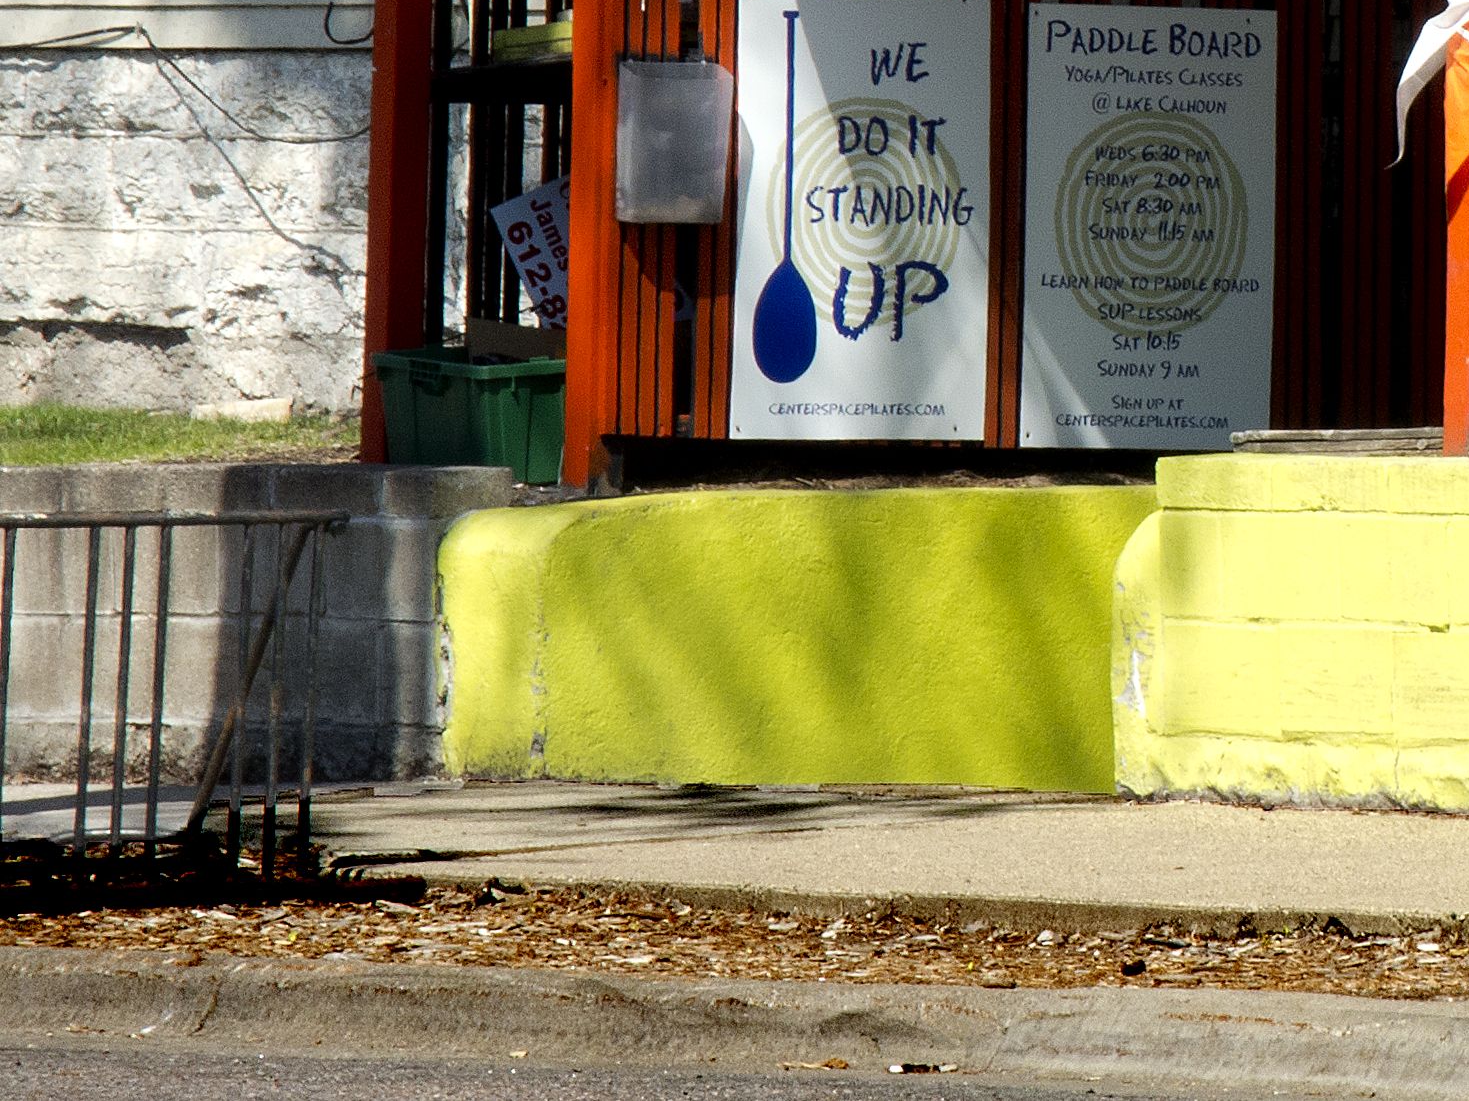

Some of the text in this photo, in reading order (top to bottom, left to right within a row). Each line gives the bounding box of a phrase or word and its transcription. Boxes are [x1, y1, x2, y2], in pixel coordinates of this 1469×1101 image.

[1045, 20, 1261, 59] PADDLE BOARD
[870, 42, 930, 85] WE
[1064, 65, 1243, 87] YOGA/PILATES CLASSES
[1092, 92, 1227, 114] @ LAKE CALHOUN
[837, 115, 947, 158] DO IT
[1095, 147, 1136, 162] WEDS
[1185, 148, 1210, 163] PM
[1084, 170, 1138, 188] FRIDAY
[1196, 176, 1221, 189] PM
[805, 185, 975, 227] STANDING
[1102, 198, 1131, 215] SAT
[1179, 202, 1202, 215] AM
[530, 200, 567, 272] James
[1088, 223, 1146, 240] SUNDAY
[1191, 228, 1215, 241] AM
[1041, 274, 1260, 293] LEARN HOW TO PADDLE BOARD
[832, 260, 949, 342] UP
[1098, 303, 1202, 322] SUP LESSONS
[1112, 334, 1140, 352] SAT
[1097, 360, 1200, 379] SUNDAY 9 AM
[768, 402, 945, 417] CENTERSPACEPILATES.COM
[1112, 396, 1184, 410] SIGN UP AT
[1056, 414, 1229, 429] CENTERSPACEPILATES.COM
